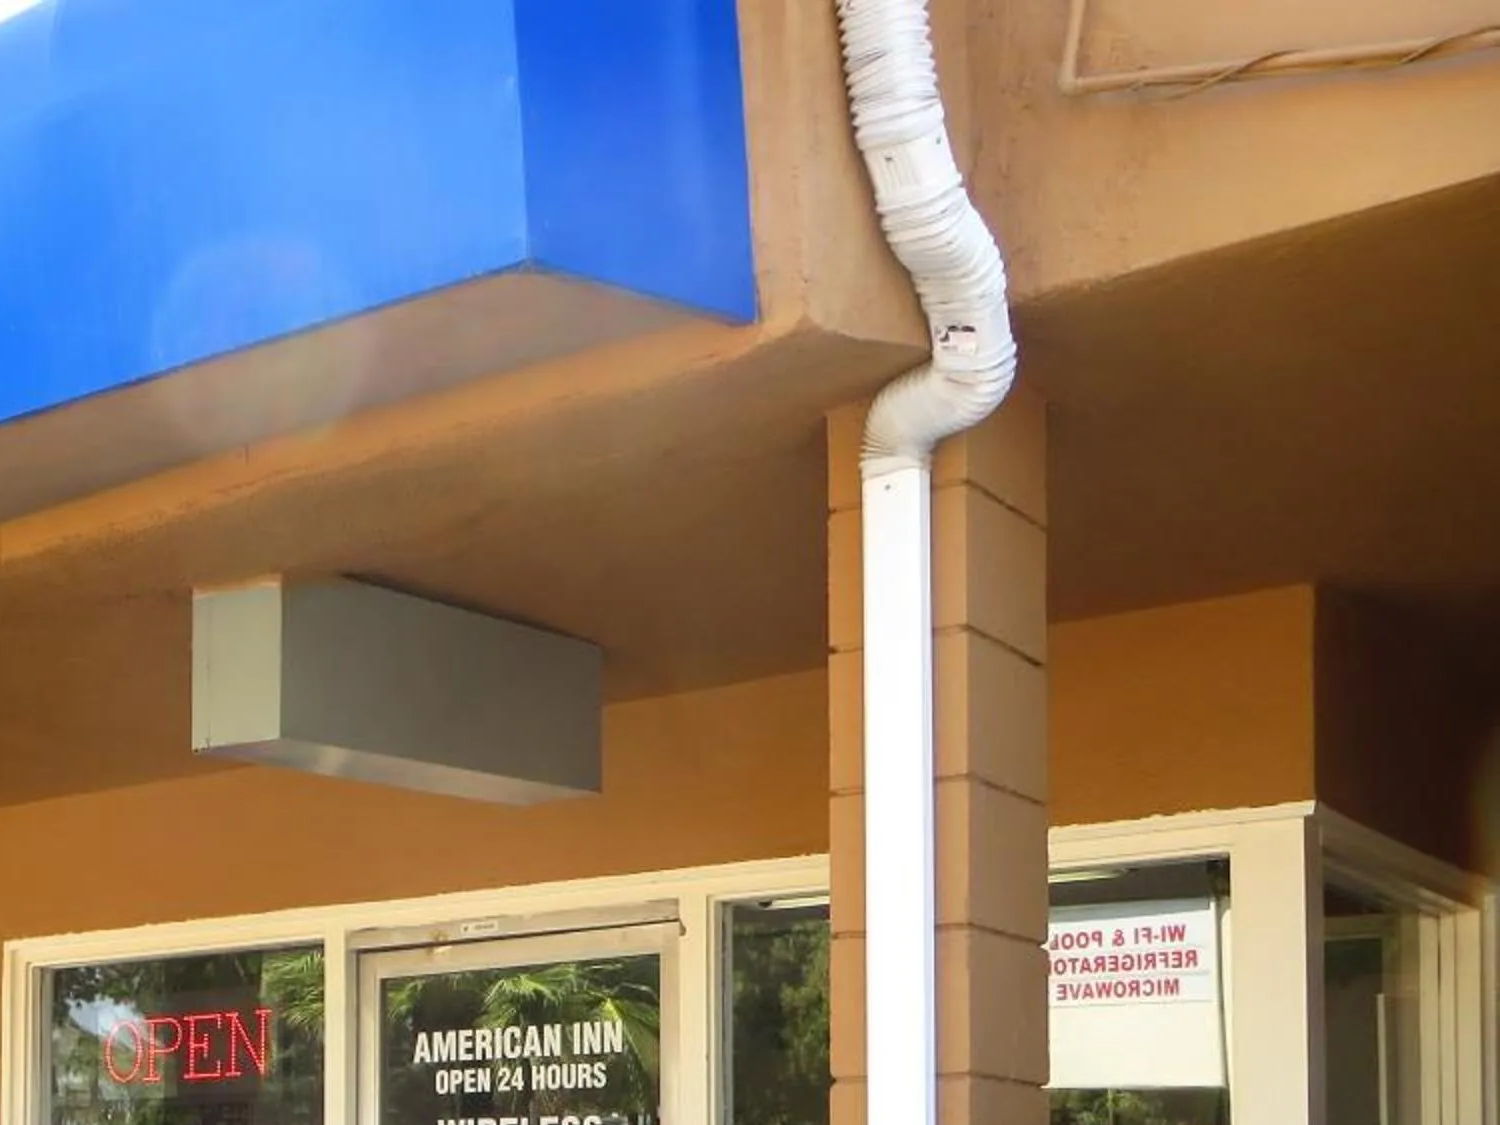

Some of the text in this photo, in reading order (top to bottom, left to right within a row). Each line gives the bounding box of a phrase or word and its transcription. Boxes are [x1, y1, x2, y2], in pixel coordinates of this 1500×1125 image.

[105, 1009, 272, 1085] OPEN
[413, 1020, 623, 1063] AMERICAN INN
[435, 1062, 607, 1094] OPEN 24 HOURS
